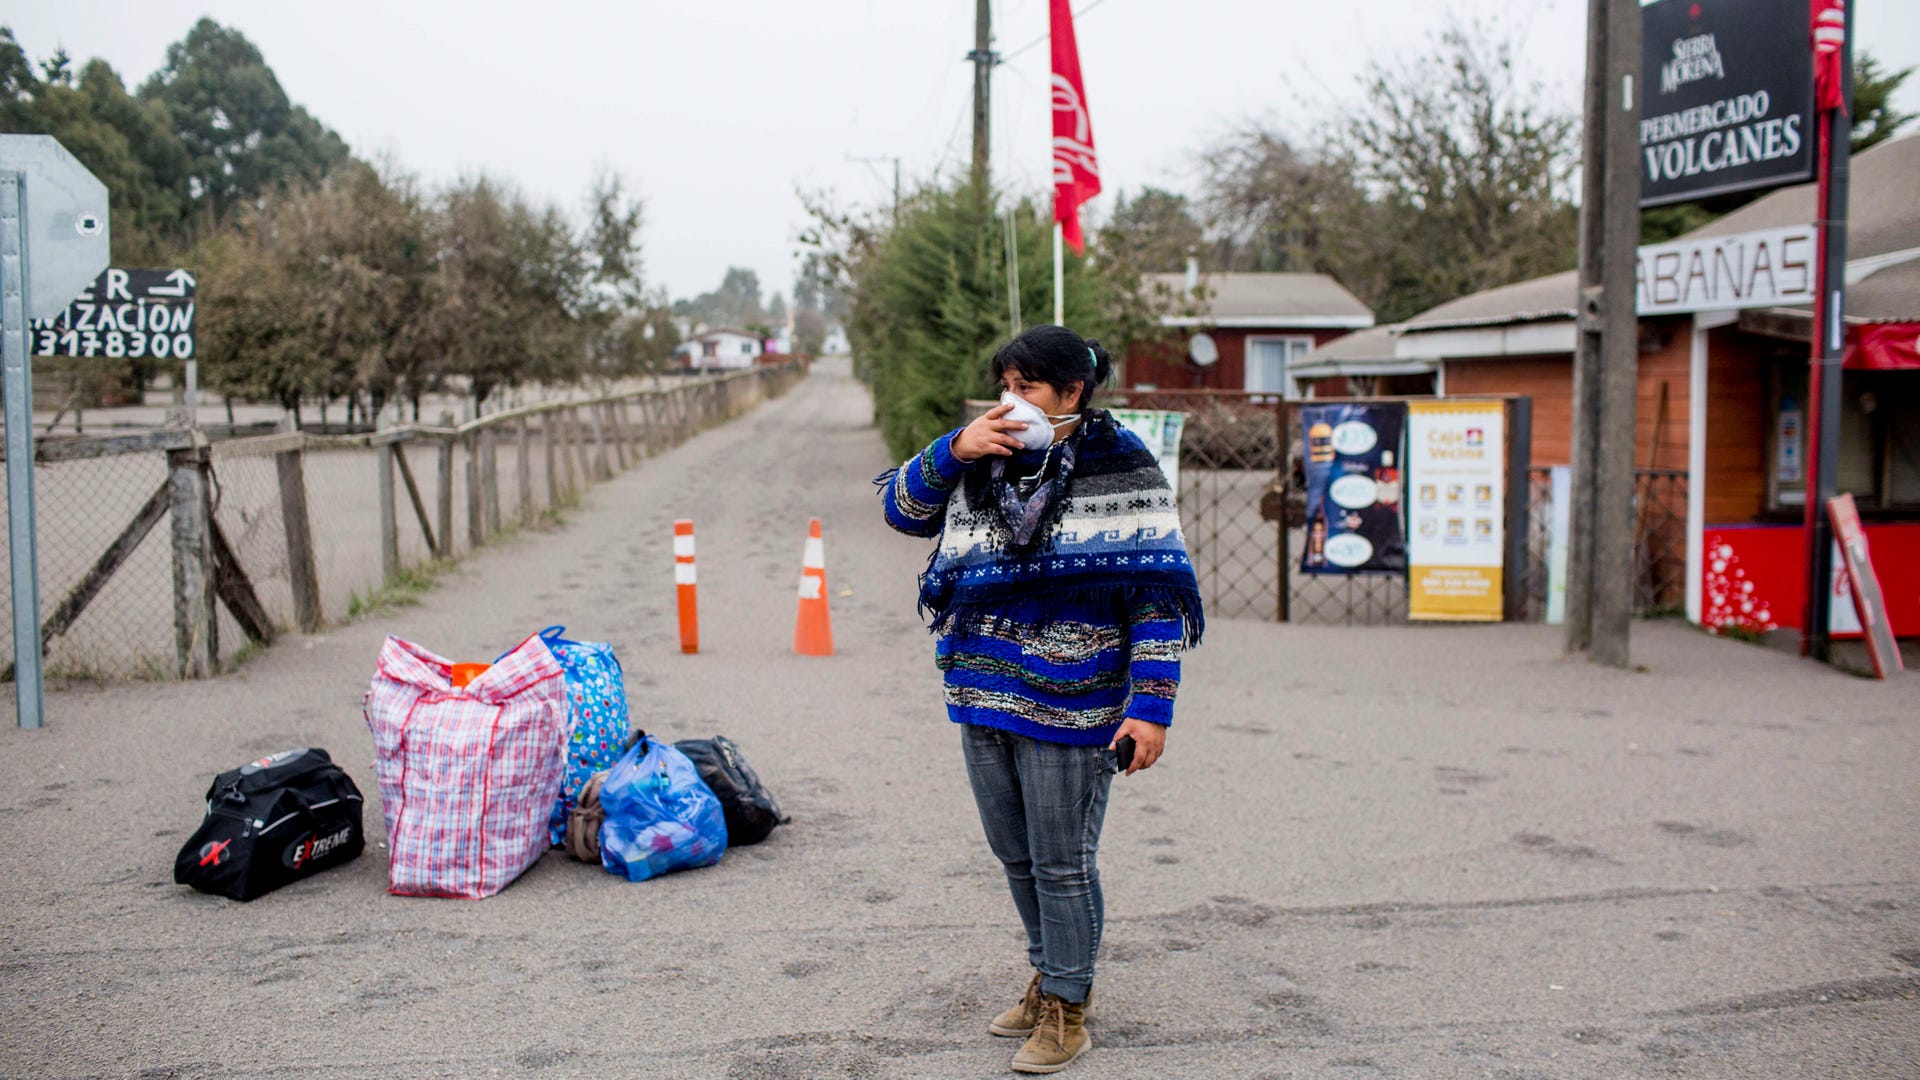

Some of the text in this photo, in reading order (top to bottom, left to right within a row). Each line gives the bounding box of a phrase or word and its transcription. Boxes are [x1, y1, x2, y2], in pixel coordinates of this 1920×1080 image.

[1646, 114, 1801, 182] VOLCANES
[29, 330, 193, 359] 3178300
[1427, 447, 1484, 459] Vecina
[293, 826, 351, 869] EXTREME
